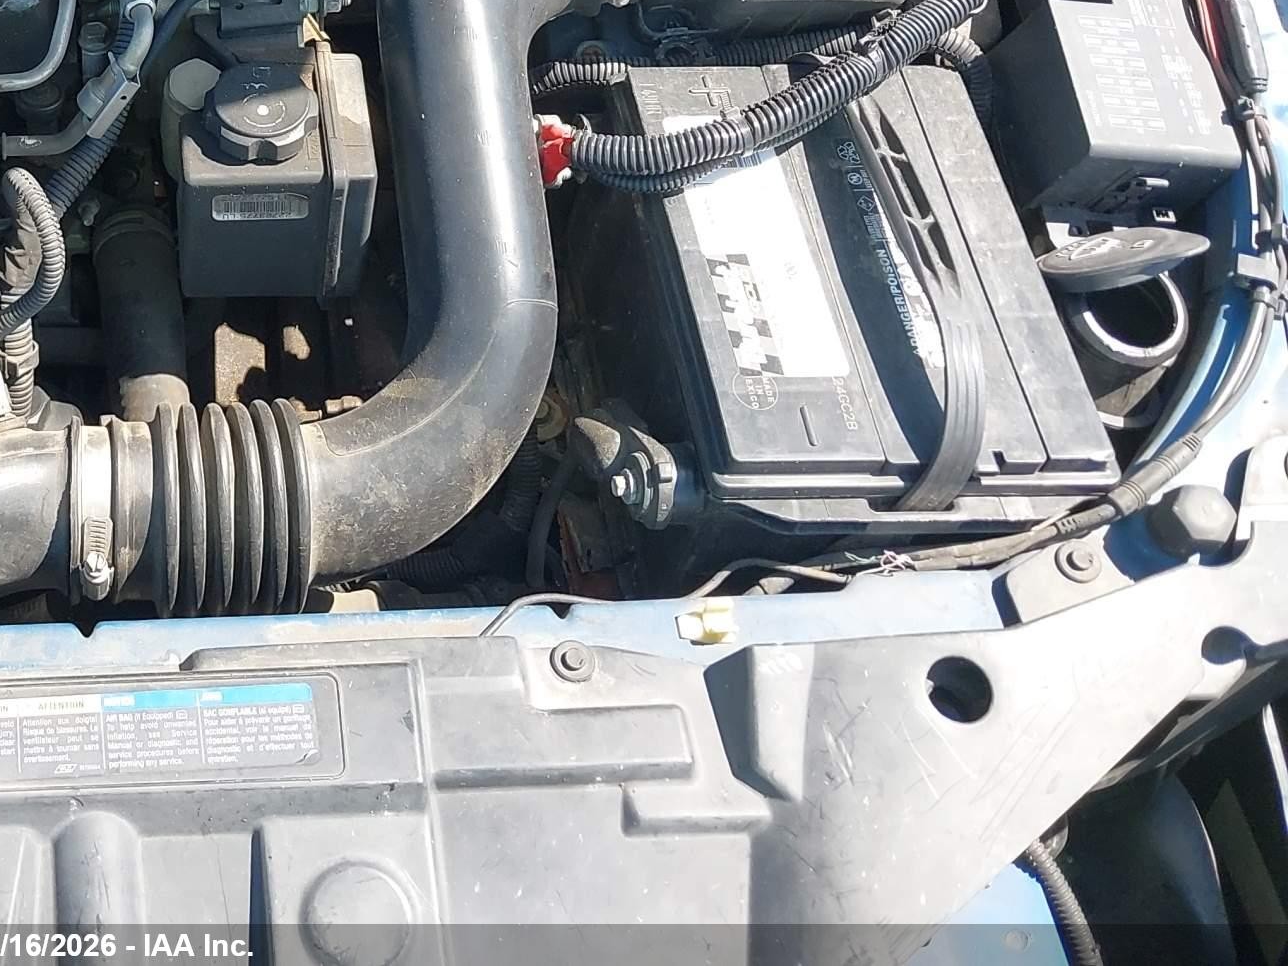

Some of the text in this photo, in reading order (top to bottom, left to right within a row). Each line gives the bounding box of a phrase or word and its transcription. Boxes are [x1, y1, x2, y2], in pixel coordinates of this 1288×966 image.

[745, 378, 760, 409] EXICO
[755, 385, 764, 395] IN
[23, 718, 52, 727] Attention
